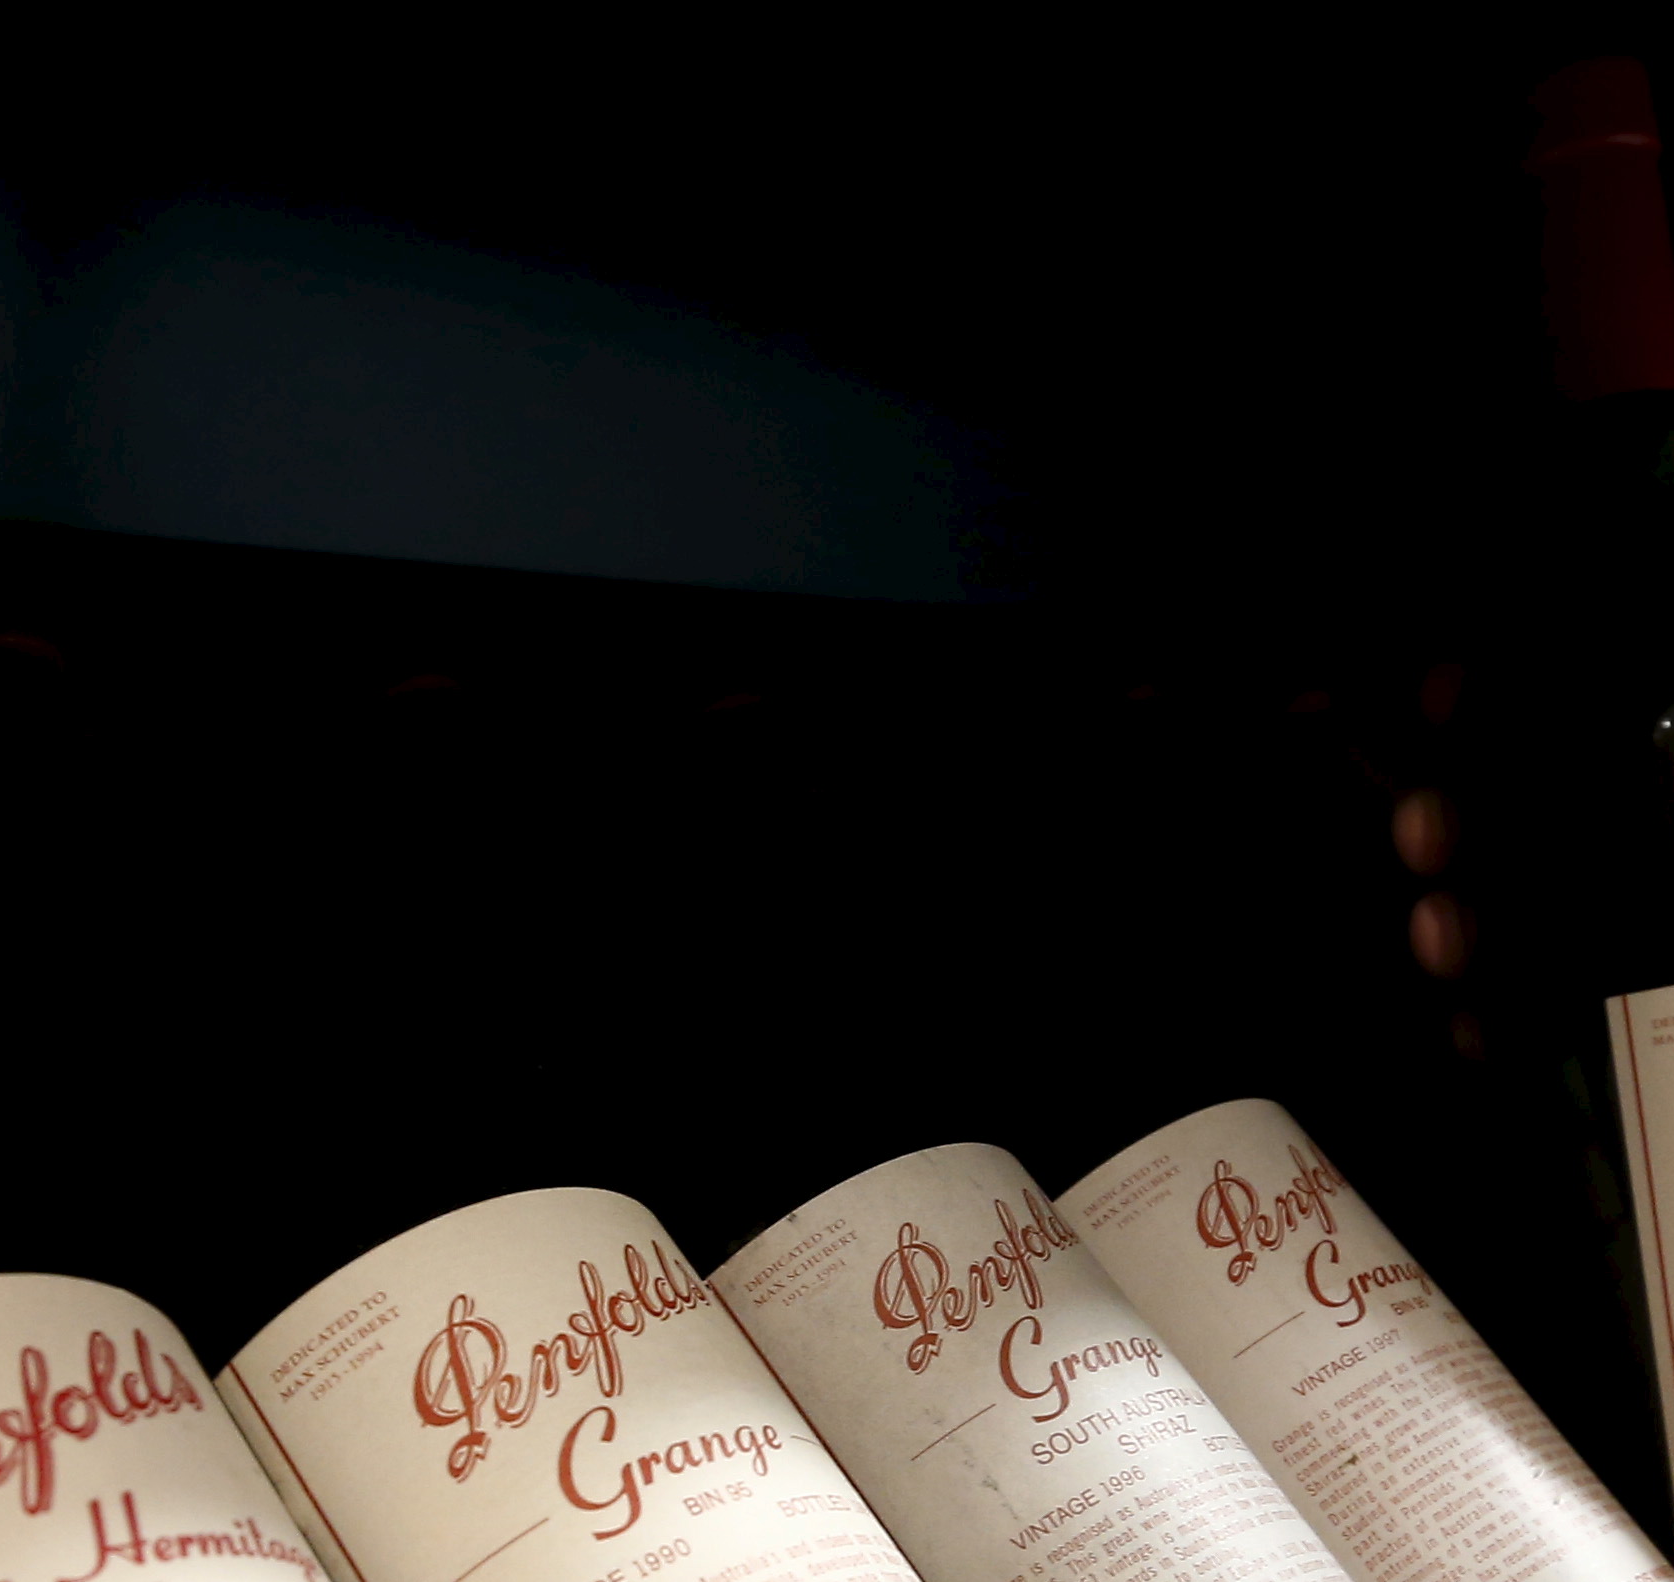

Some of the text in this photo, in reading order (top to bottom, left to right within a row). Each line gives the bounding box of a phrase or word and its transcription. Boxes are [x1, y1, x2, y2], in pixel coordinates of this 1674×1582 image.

[743, 1216, 848, 1295] DEDICATED TO
[751, 1228, 861, 1309] MAX SCHUBERT
[268, 1288, 390, 1387] DEDICATED TO
[276, 1303, 405, 1404] MAX SCHUBERT
[999, 1316, 1164, 1424] Grange
[1291, 1328, 1402, 1397] VINTAGE 1997
[558, 1405, 783, 1541] Grange
[1031, 1409, 1121, 1467] SOUTH
[1119, 1414, 1198, 1458] SHIRAZ
[683, 1481, 753, 1520] BIN 95
[1010, 1464, 1147, 1550] VINTAGE 1996
[633, 1538, 692, 1580] 1990
[1029, 1560, 1044, 1576] is
[1045, 1513, 1115, 1567] recognised
[1117, 1504, 1134, 1522] as
[1067, 1548, 1099, 1575] This
[1101, 1525, 1140, 1558] great
